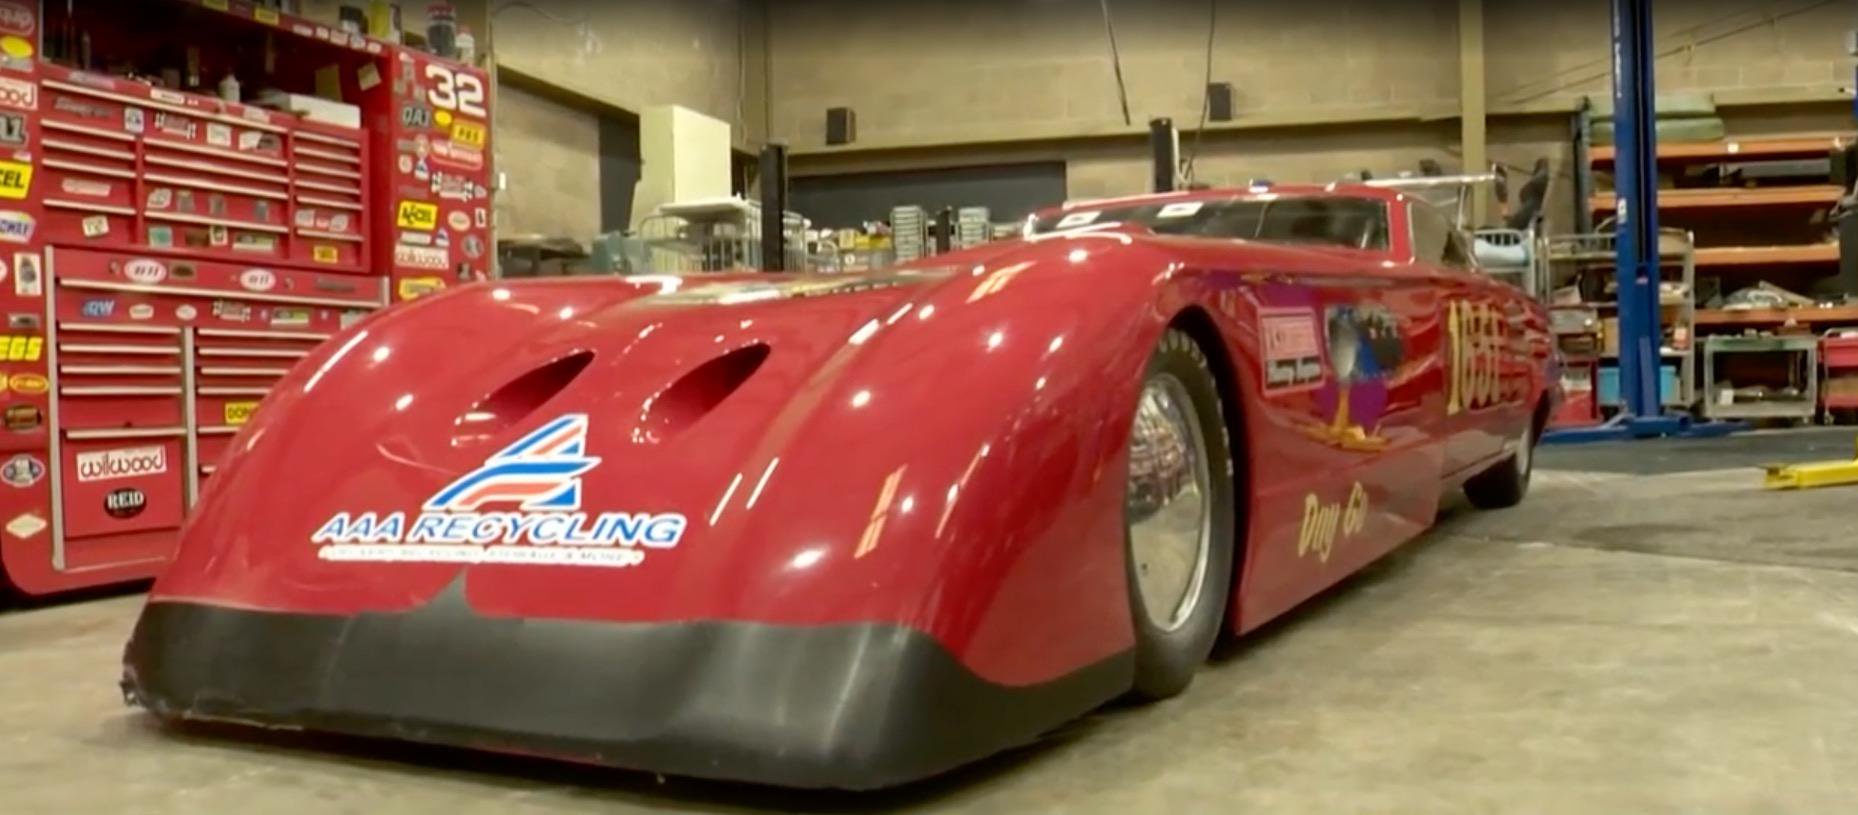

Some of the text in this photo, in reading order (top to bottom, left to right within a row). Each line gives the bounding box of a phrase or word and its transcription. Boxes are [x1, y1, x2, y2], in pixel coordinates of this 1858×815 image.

[426, 65, 487, 117] 32
[81, 447, 165, 477] wilwood
[107, 490, 144, 509] REID
[316, 514, 685, 547] AAA RECYCLING
